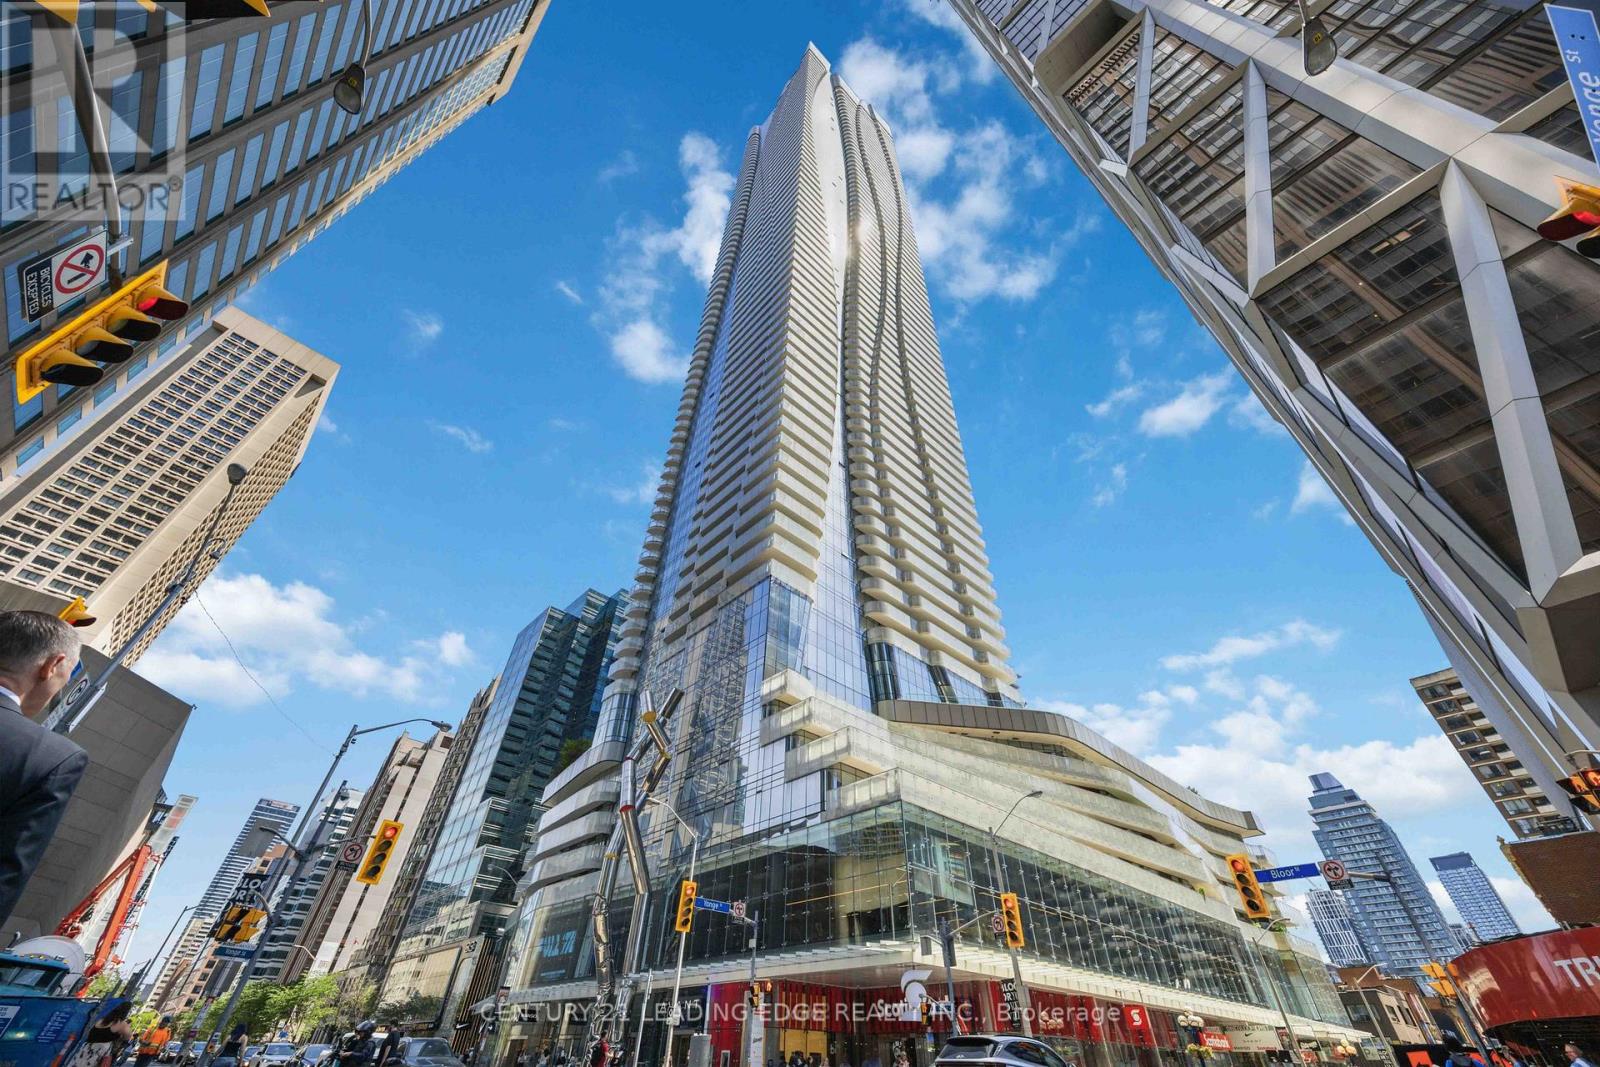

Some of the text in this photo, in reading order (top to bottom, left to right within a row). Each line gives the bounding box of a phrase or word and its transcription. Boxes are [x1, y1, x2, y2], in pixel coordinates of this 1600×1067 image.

[1565, 49, 1582, 64] St
[27, 271, 39, 315] EXCEPTED
[40, 267, 52, 308] BICYCLES
[1270, 868, 1295, 879] Bloor
[703, 899, 719, 910] Yonge
[1553, 955, 1600, 988] TR
